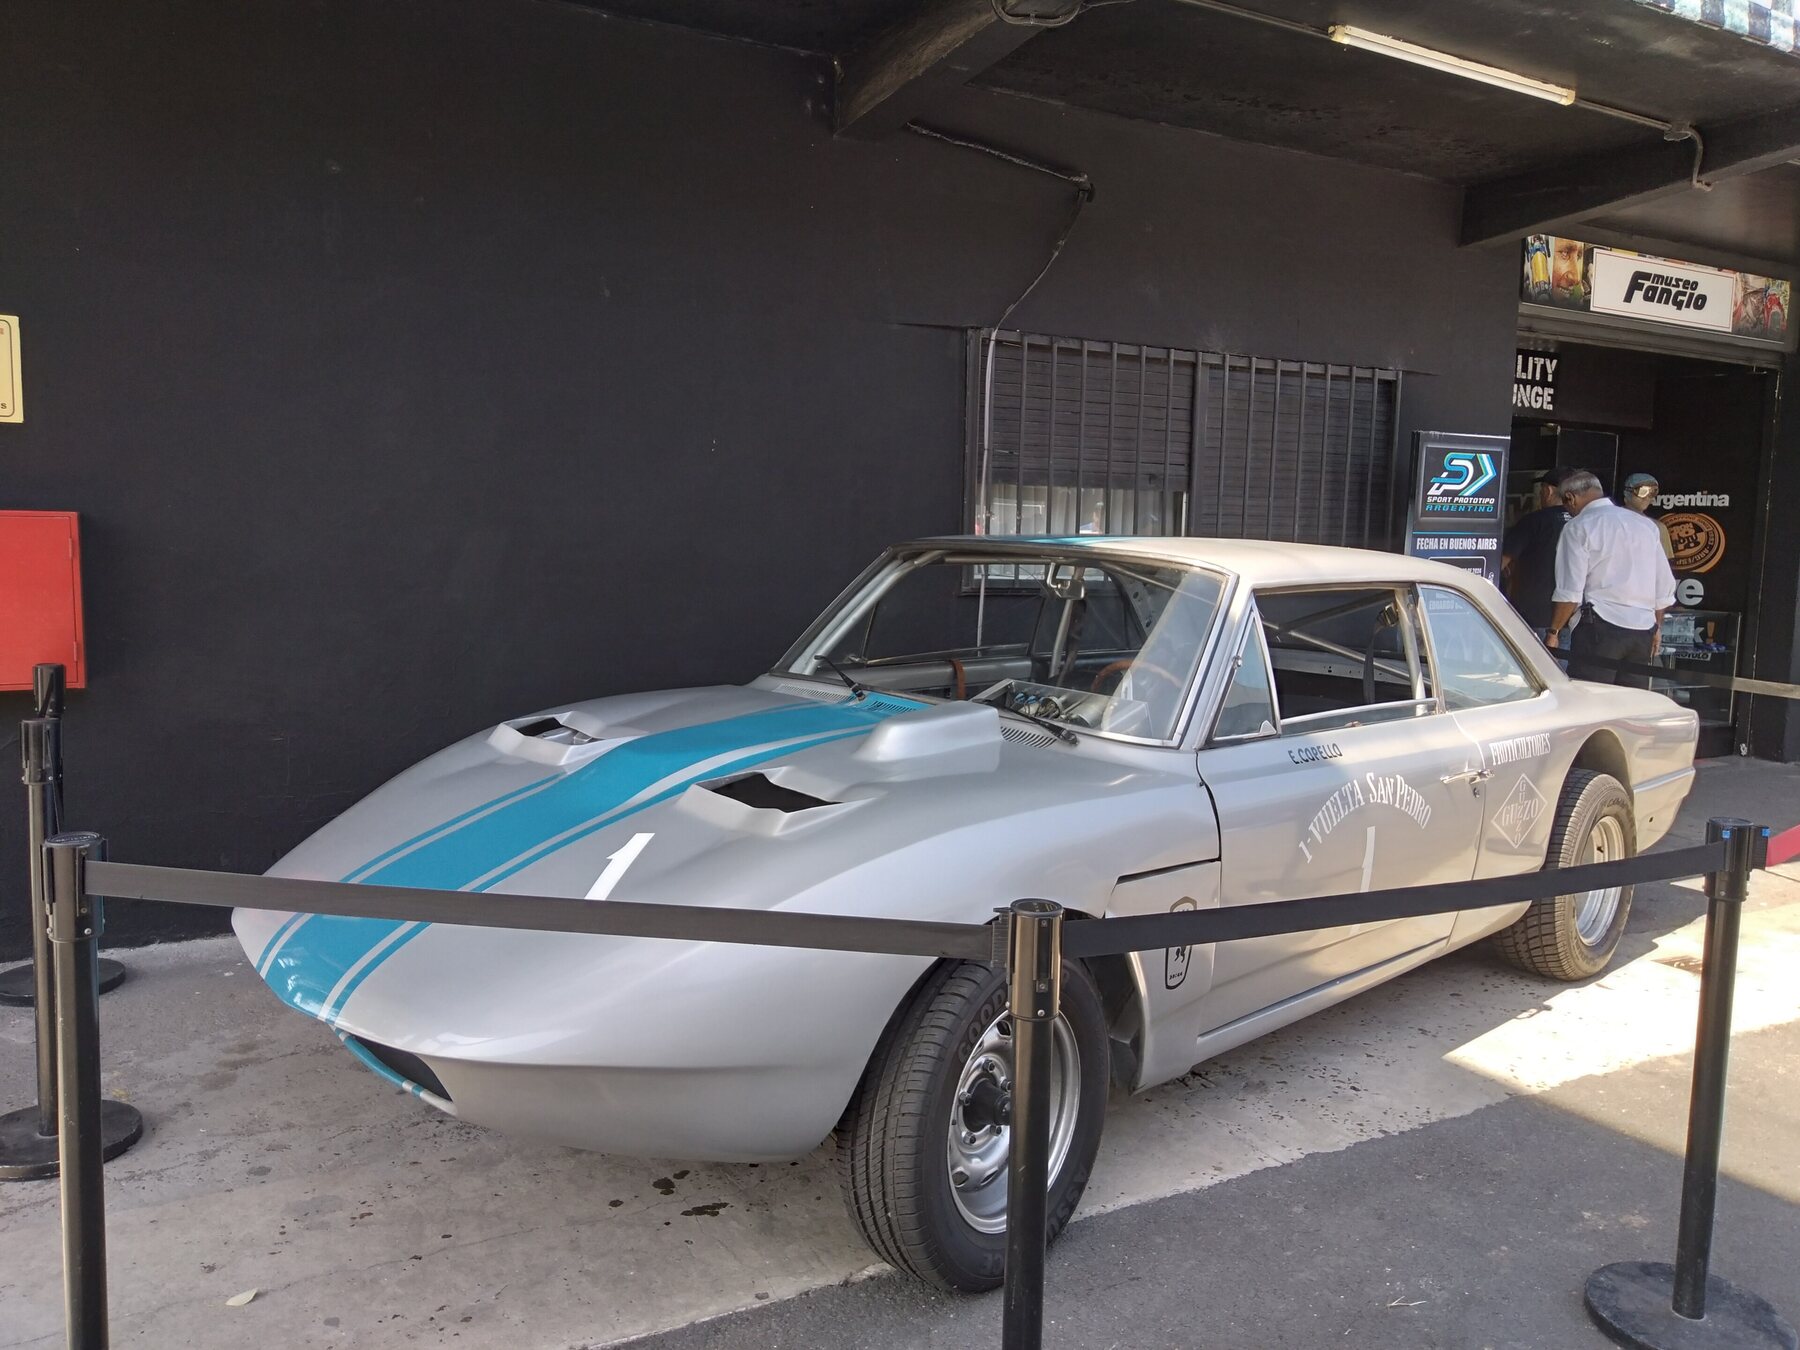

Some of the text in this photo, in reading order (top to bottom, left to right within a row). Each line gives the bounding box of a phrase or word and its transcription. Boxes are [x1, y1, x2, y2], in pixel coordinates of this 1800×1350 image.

[1651, 273, 1699, 291] museo
[1453, 496, 1495, 504] PROTOTIPO
[1416, 537, 1498, 550] FECHA EN BUENOS AIRES
[1489, 733, 1551, 766] FRUTICULTORES
[583, 832, 656, 900] 1
